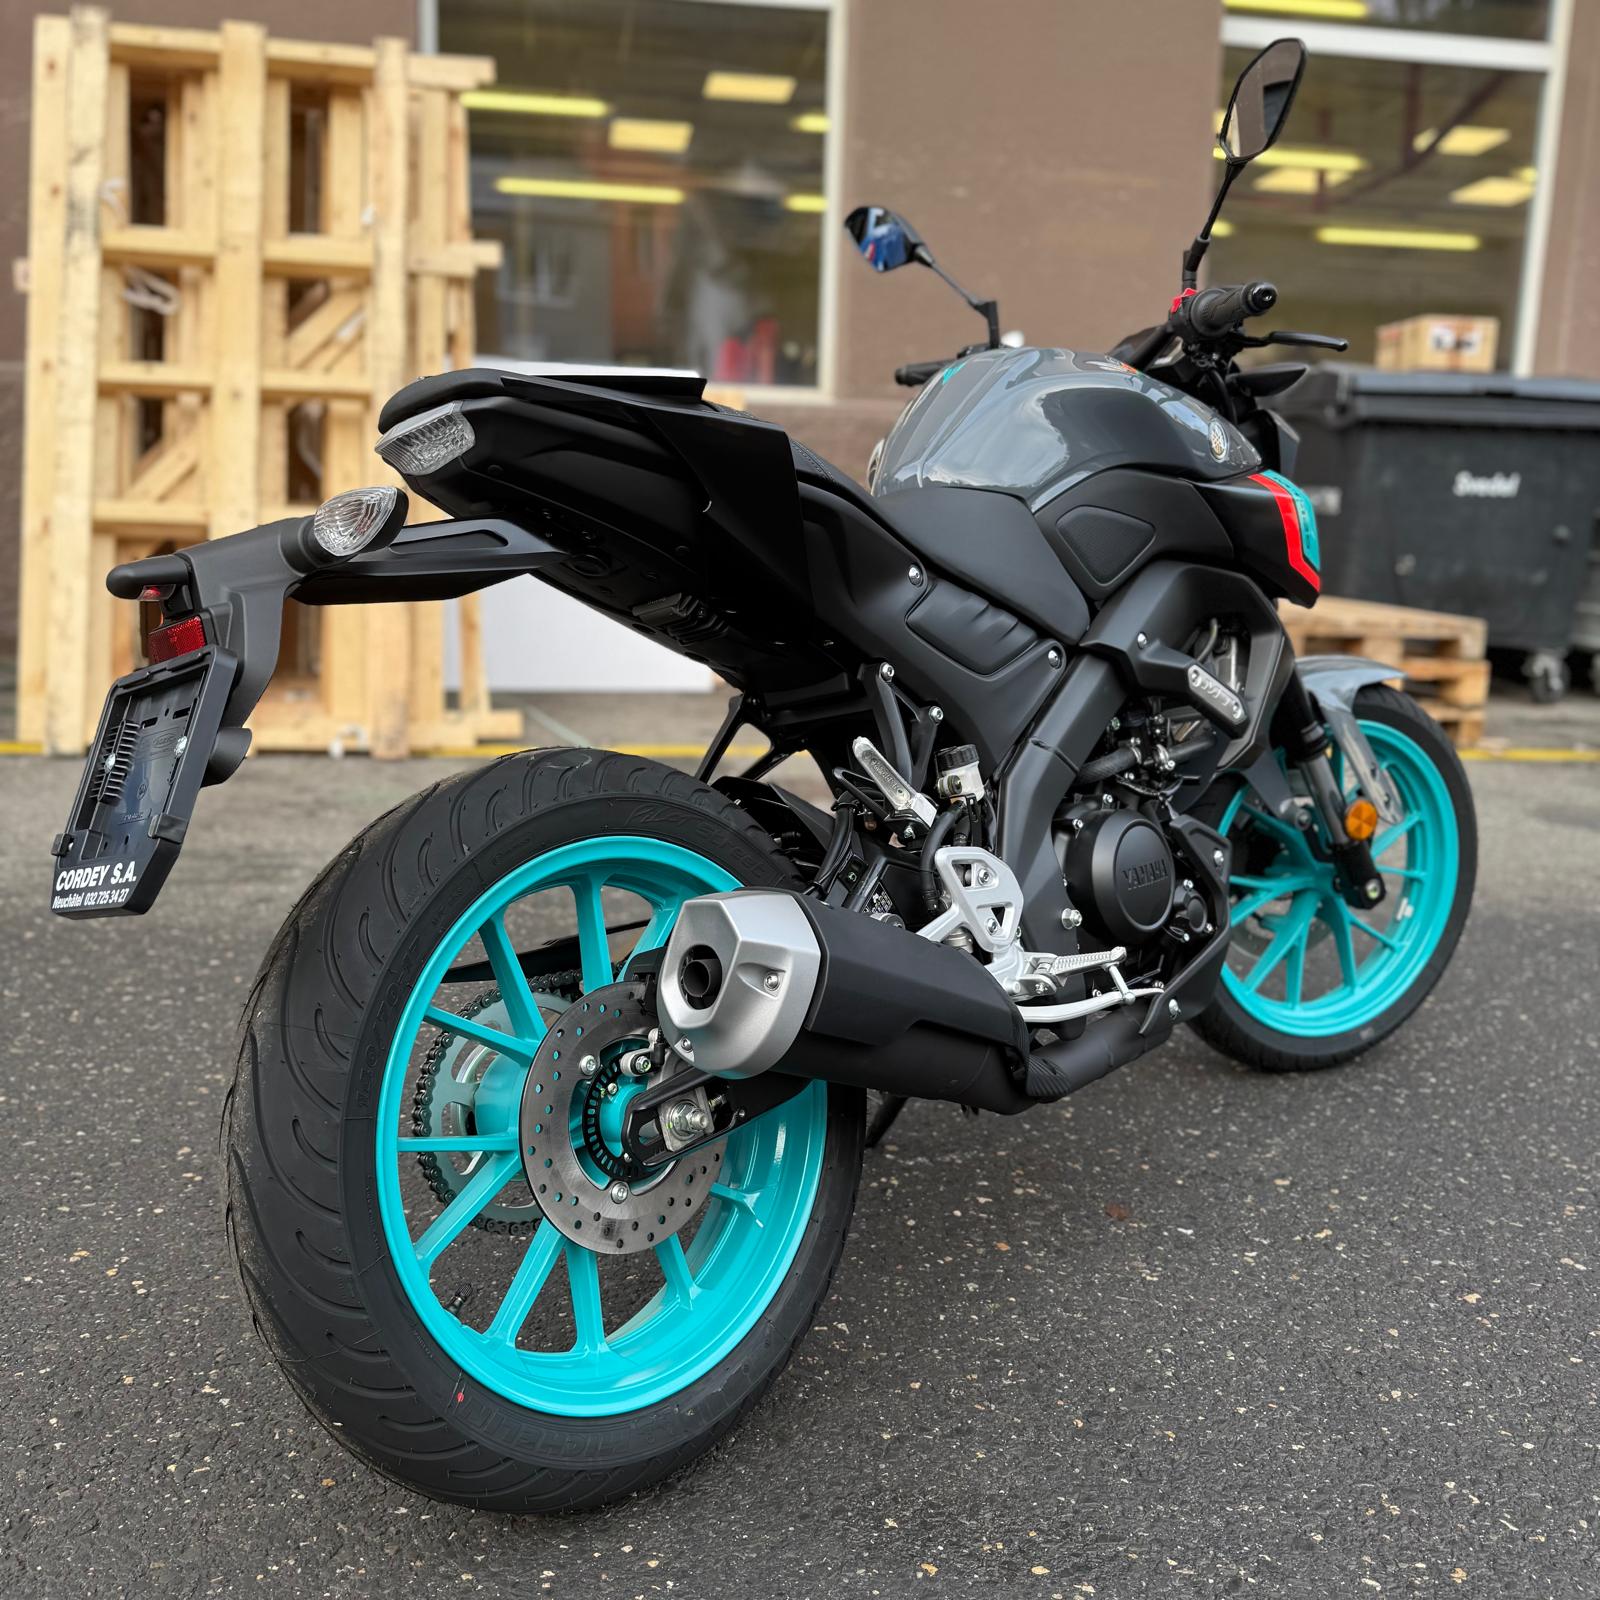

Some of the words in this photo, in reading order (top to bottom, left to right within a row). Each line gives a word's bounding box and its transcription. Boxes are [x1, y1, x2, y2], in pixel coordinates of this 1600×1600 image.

[55, 864, 111, 892] CORDEY
[110, 860, 137, 885] S.A.
[1122, 859, 1168, 890] YAMAHA
[52, 893, 84, 909] Neuchâtel
[84, 891, 97, 906] 032
[97, 889, 110, 905] 725
[110, 889, 120, 903] 34
[118, 888, 129, 902] 27
